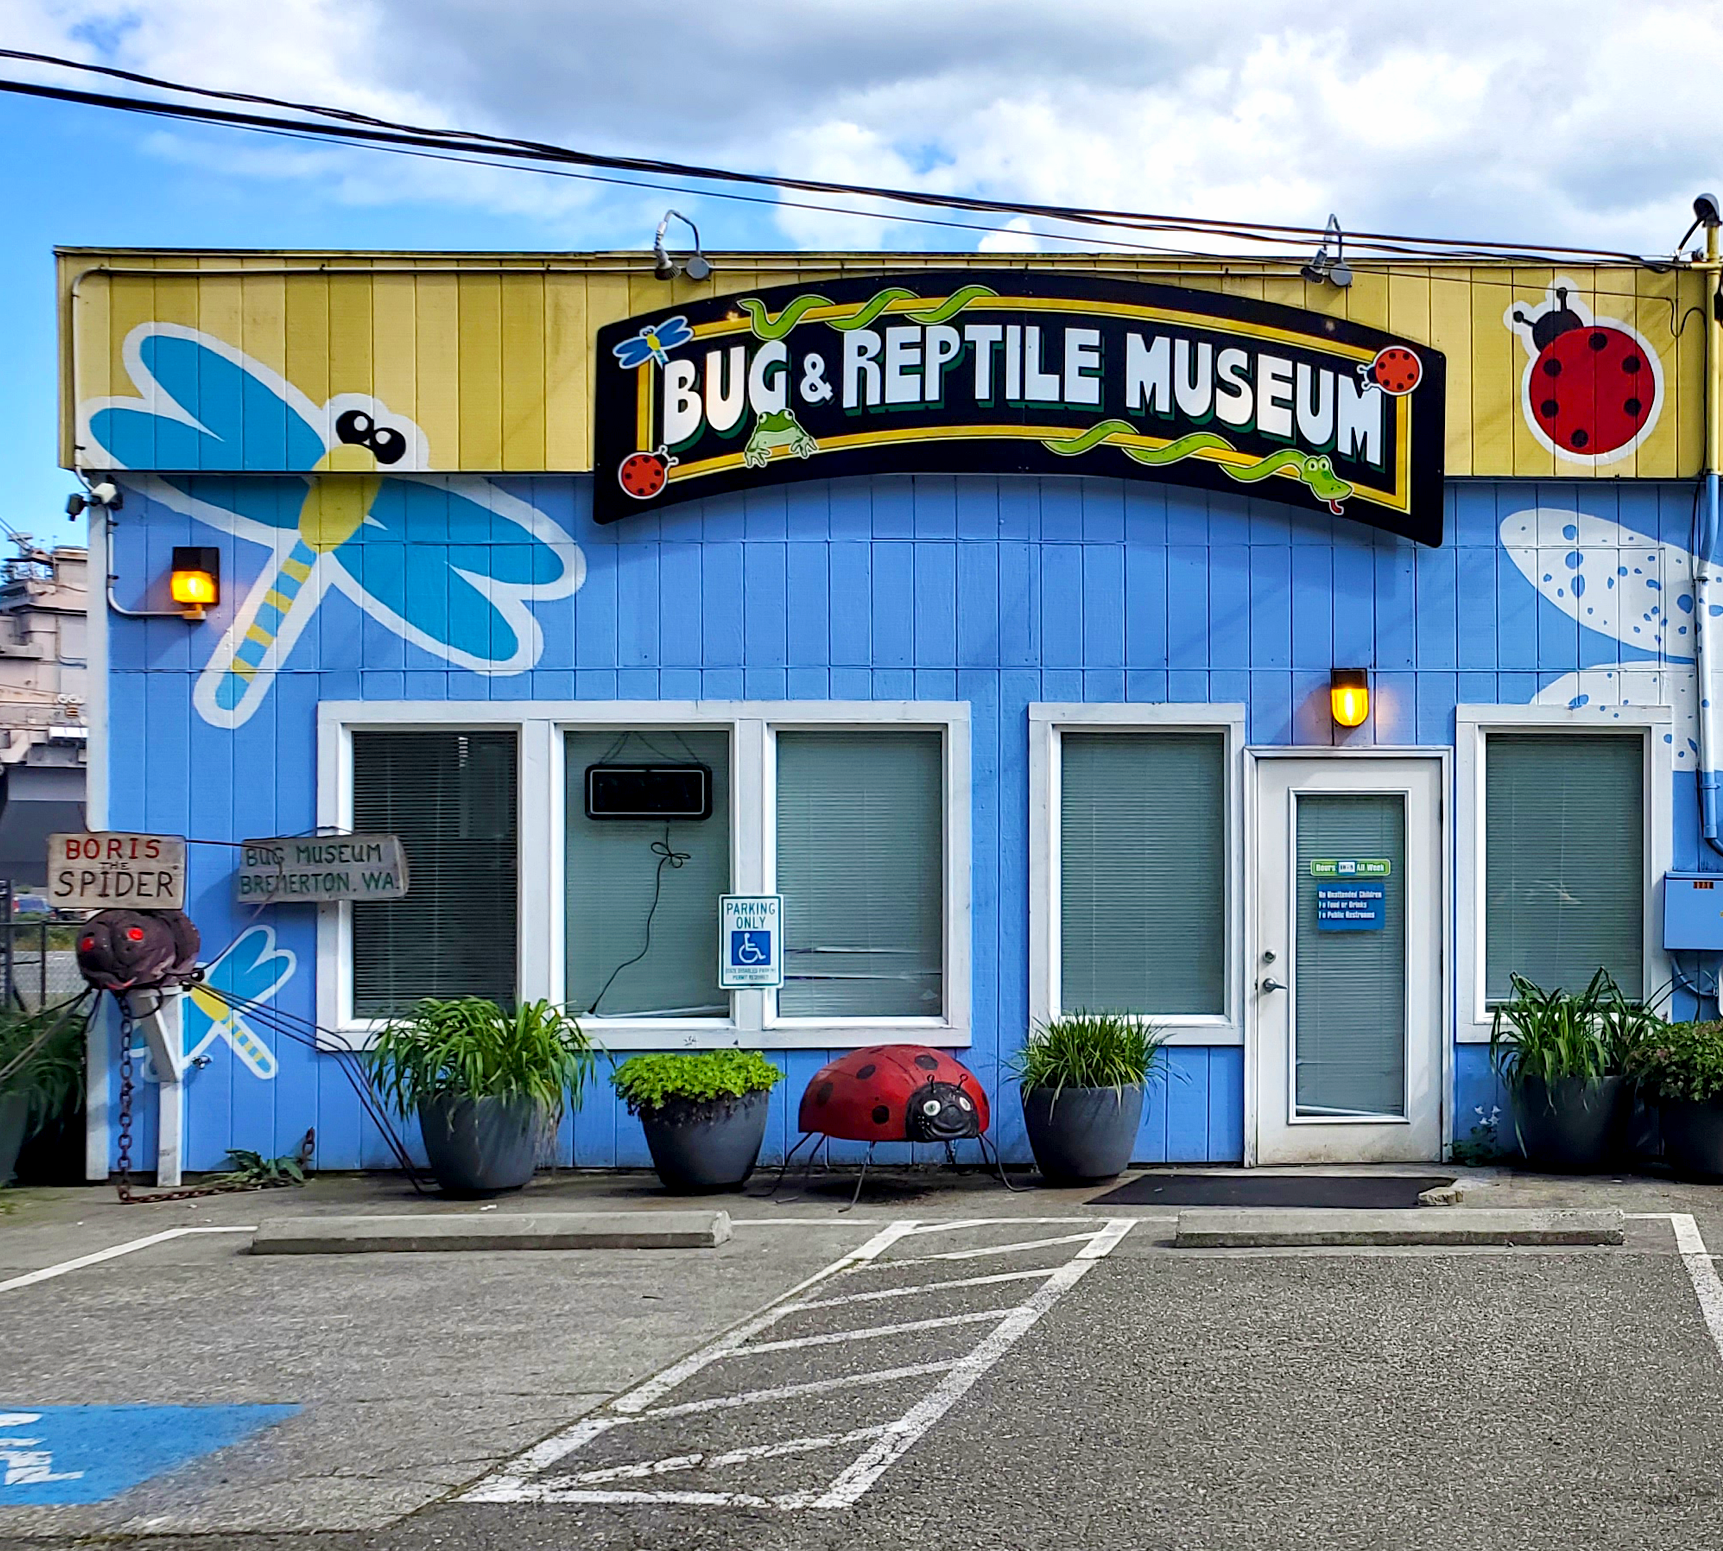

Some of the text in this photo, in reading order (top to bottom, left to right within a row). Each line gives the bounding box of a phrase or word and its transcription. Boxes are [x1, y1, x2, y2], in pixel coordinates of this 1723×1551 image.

[663, 324, 1382, 466] BUG & REPTILE MUSEUM
[66, 838, 162, 860] BORIS
[246, 843, 382, 867] BUG MUSEUM
[100, 861, 130, 871] THE
[1357, 863, 1366, 871] All
[54, 870, 174, 899] SPIDER
[726, 902, 776, 915] PARKING
[736, 916, 766, 929] ONLY
